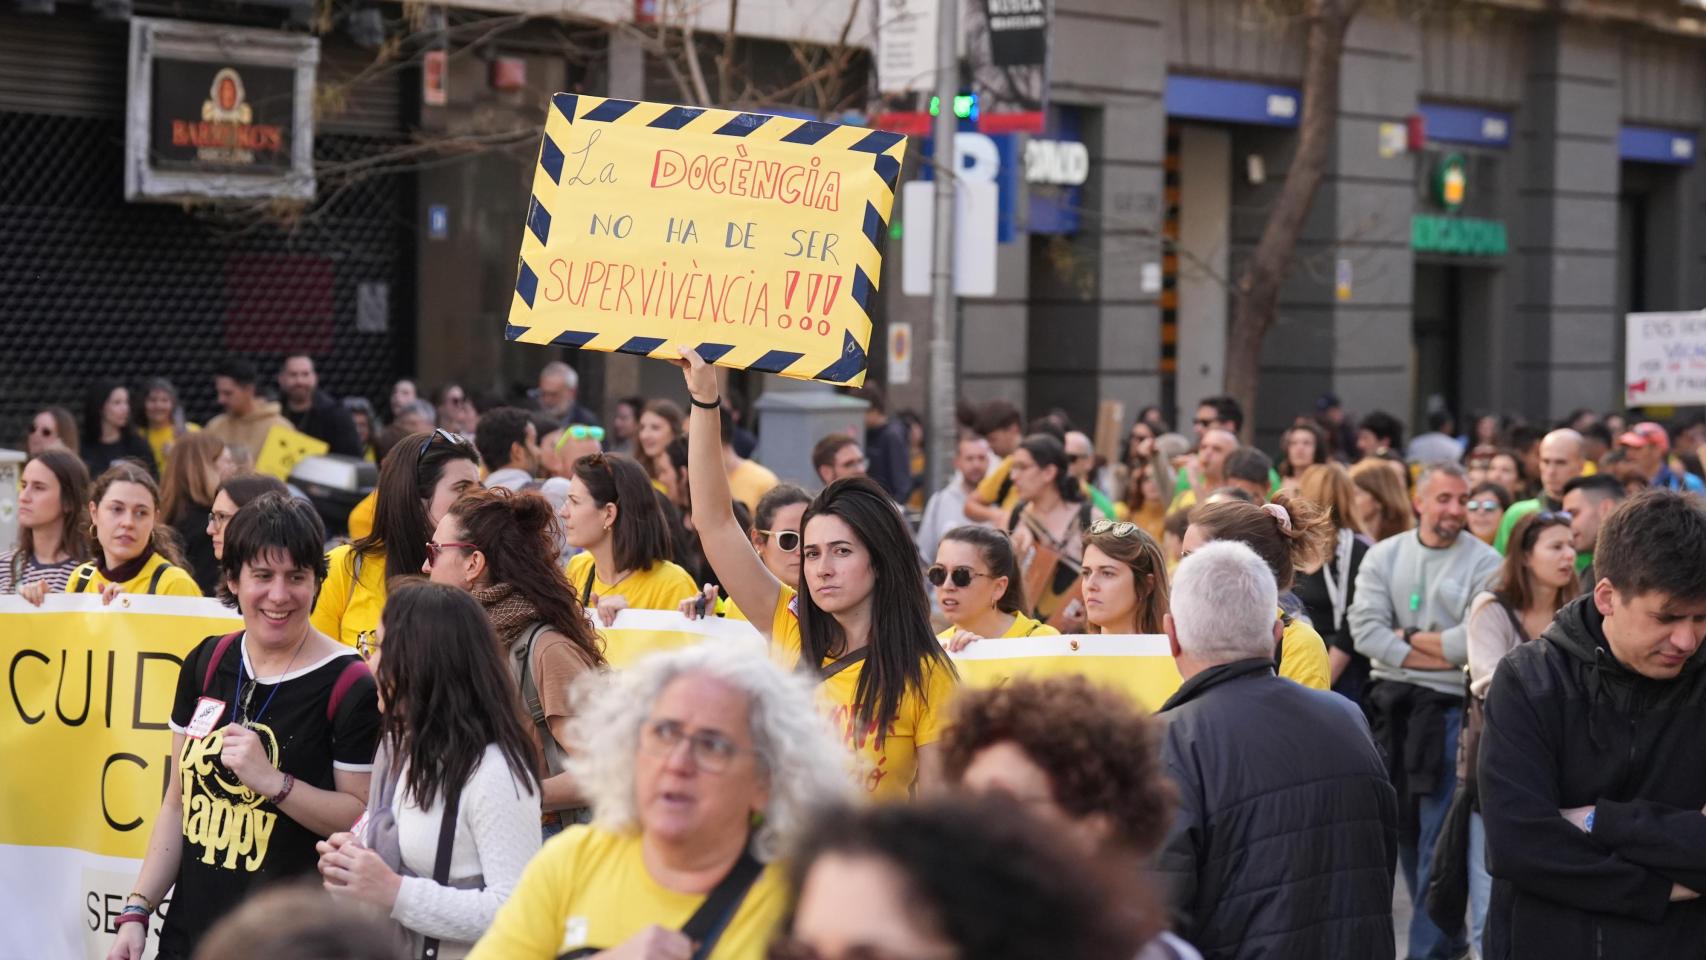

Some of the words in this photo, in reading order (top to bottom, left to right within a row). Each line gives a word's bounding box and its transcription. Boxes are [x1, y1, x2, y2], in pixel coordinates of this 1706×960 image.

[568, 129, 618, 186] La
[590, 214, 633, 239] NO
[665, 217, 698, 245] HA
[725, 222, 757, 250] DE
[784, 229, 840, 266] SER
[9, 649, 184, 731] CUID
[101, 753, 172, 832] C
[87, 891, 172, 937] SES
